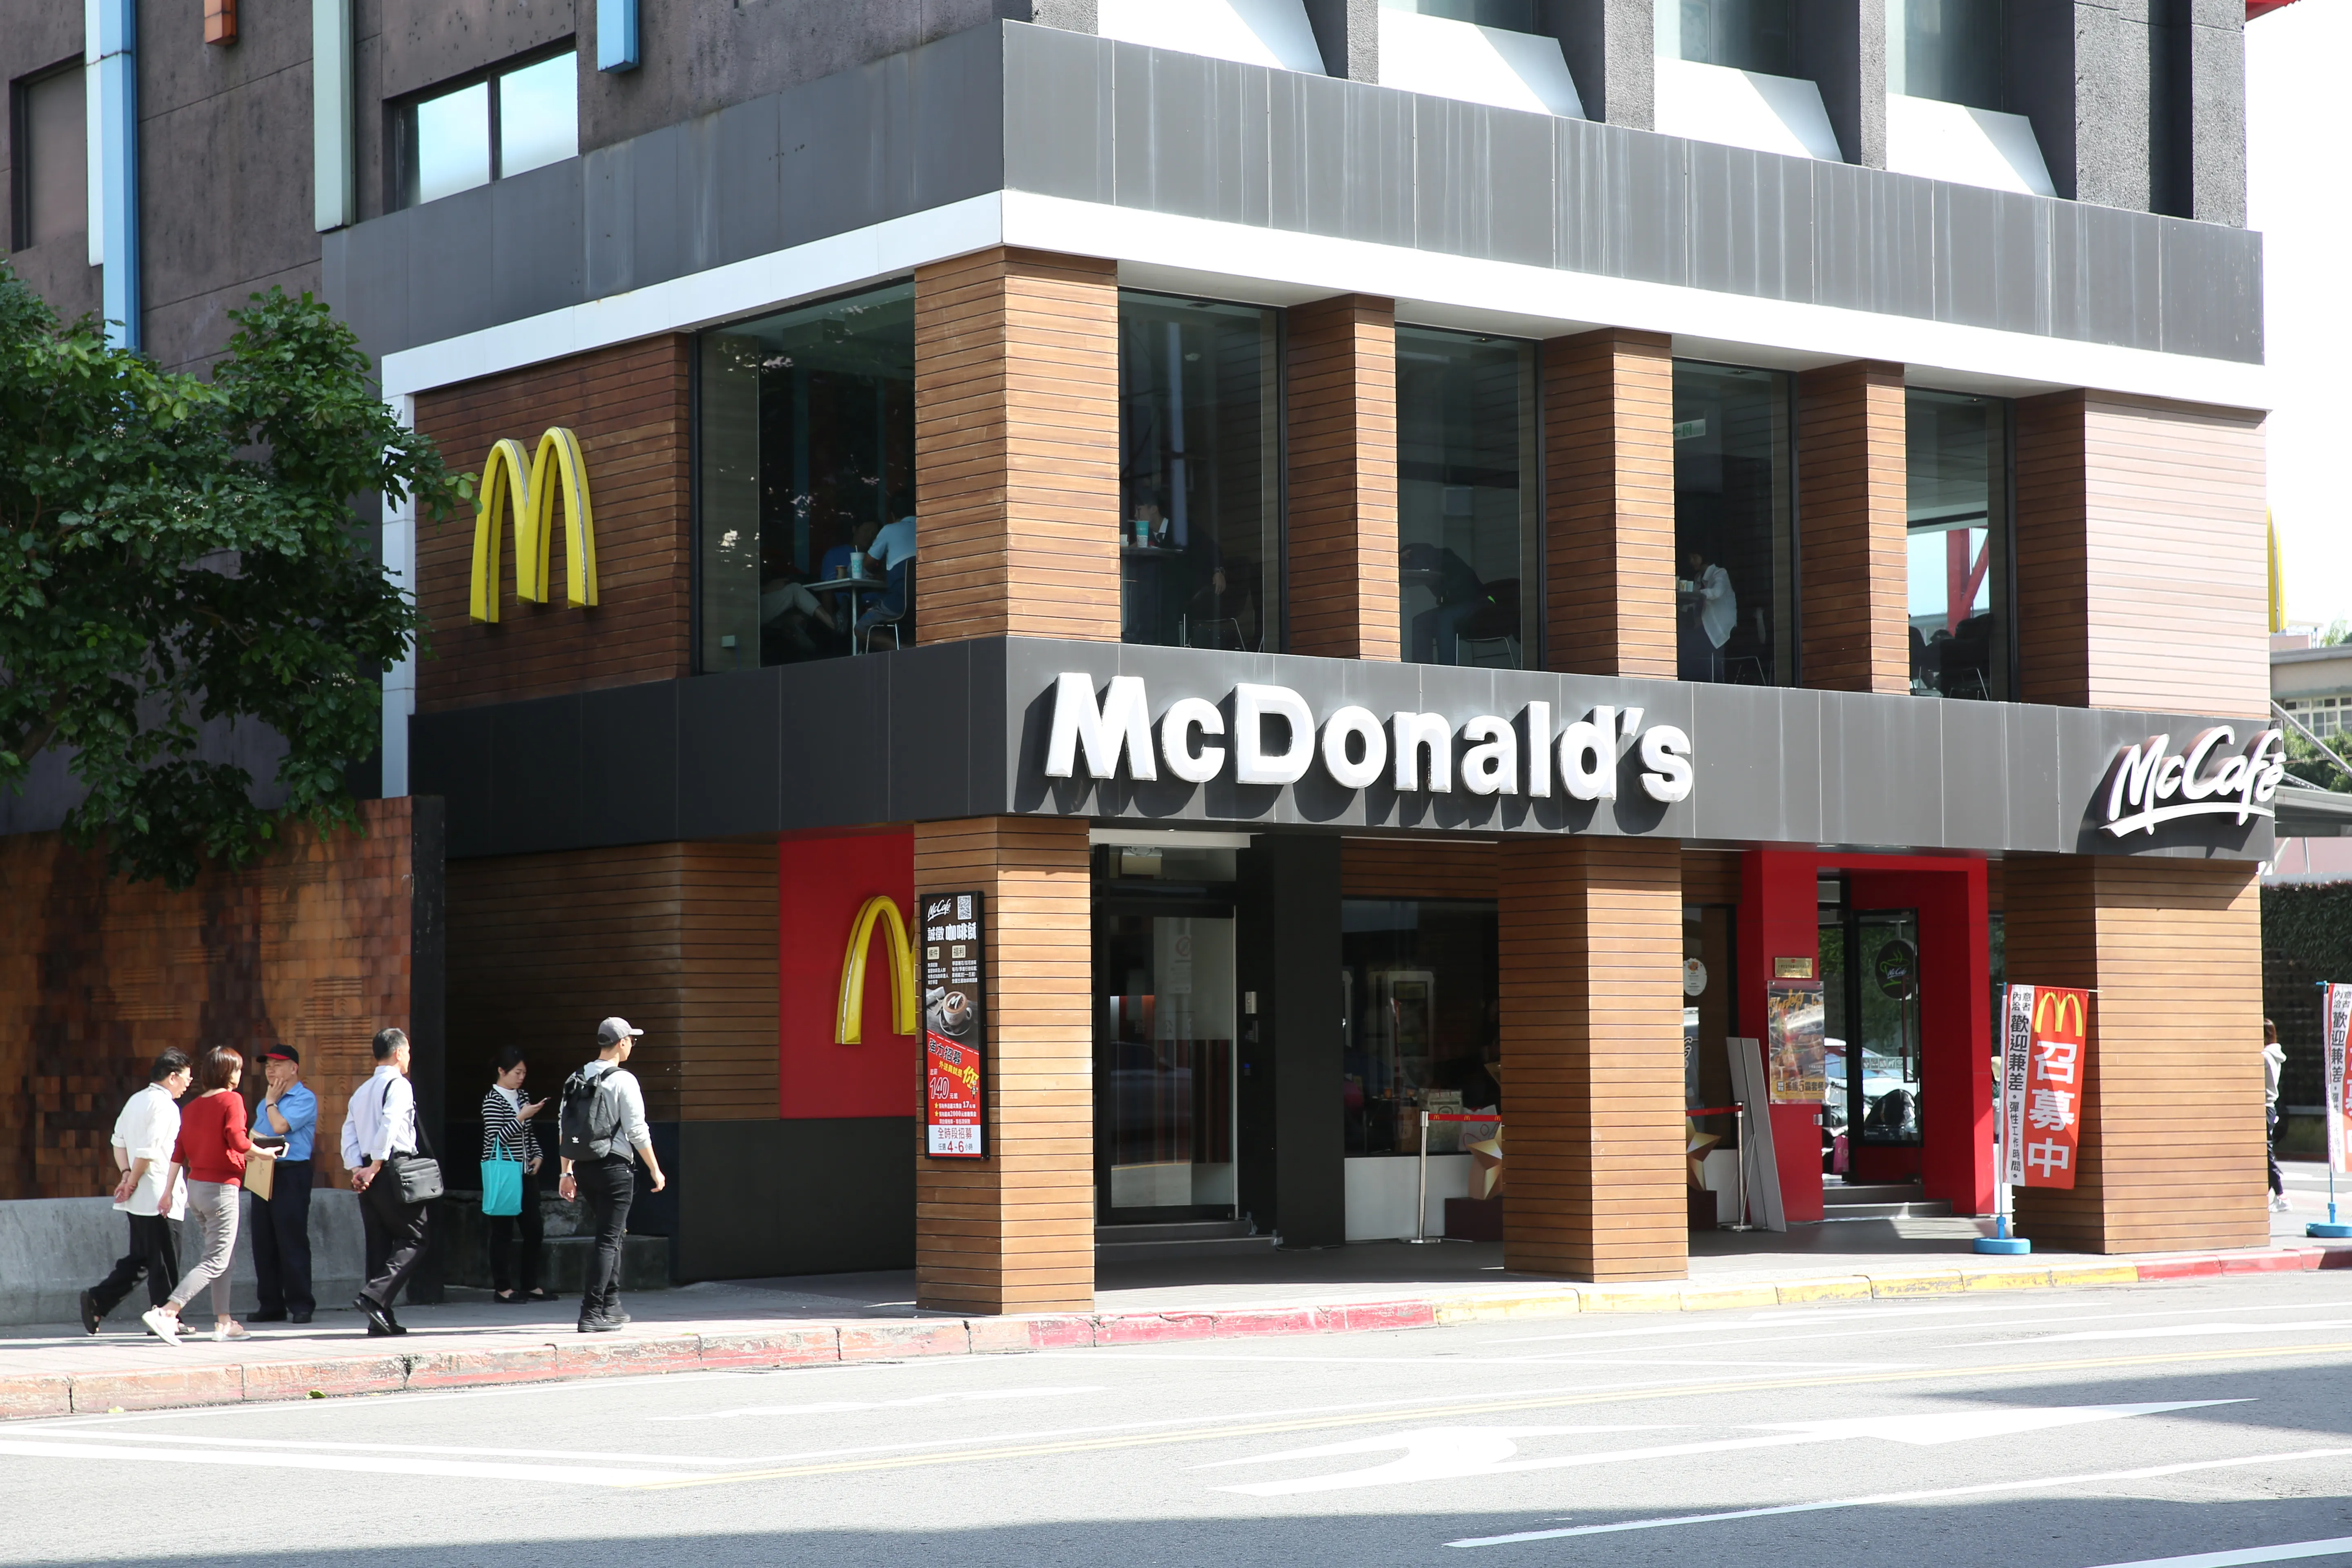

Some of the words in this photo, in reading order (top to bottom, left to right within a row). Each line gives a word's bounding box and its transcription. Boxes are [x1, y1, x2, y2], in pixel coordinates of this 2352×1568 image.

[1045, 672, 1694, 803] McDonald's
[2105, 725, 2287, 836] McCafé
[927, 898, 951, 921] McCafé
[945, 922, 976, 941] 咖啡師
[953, 947, 964, 956] 福利
[929, 1038, 962, 1065] 強力招募
[2008, 1014, 2029, 1091] 歡迎兼差
[2330, 1011, 2347, 1083] 歡迎兼差
[929, 1077, 949, 1099] 140
[2027, 1040, 2077, 1178] 召募中
[938, 1127, 972, 1139] 全時段招募
[2009, 1102, 2021, 1172] 彈性工作時間
